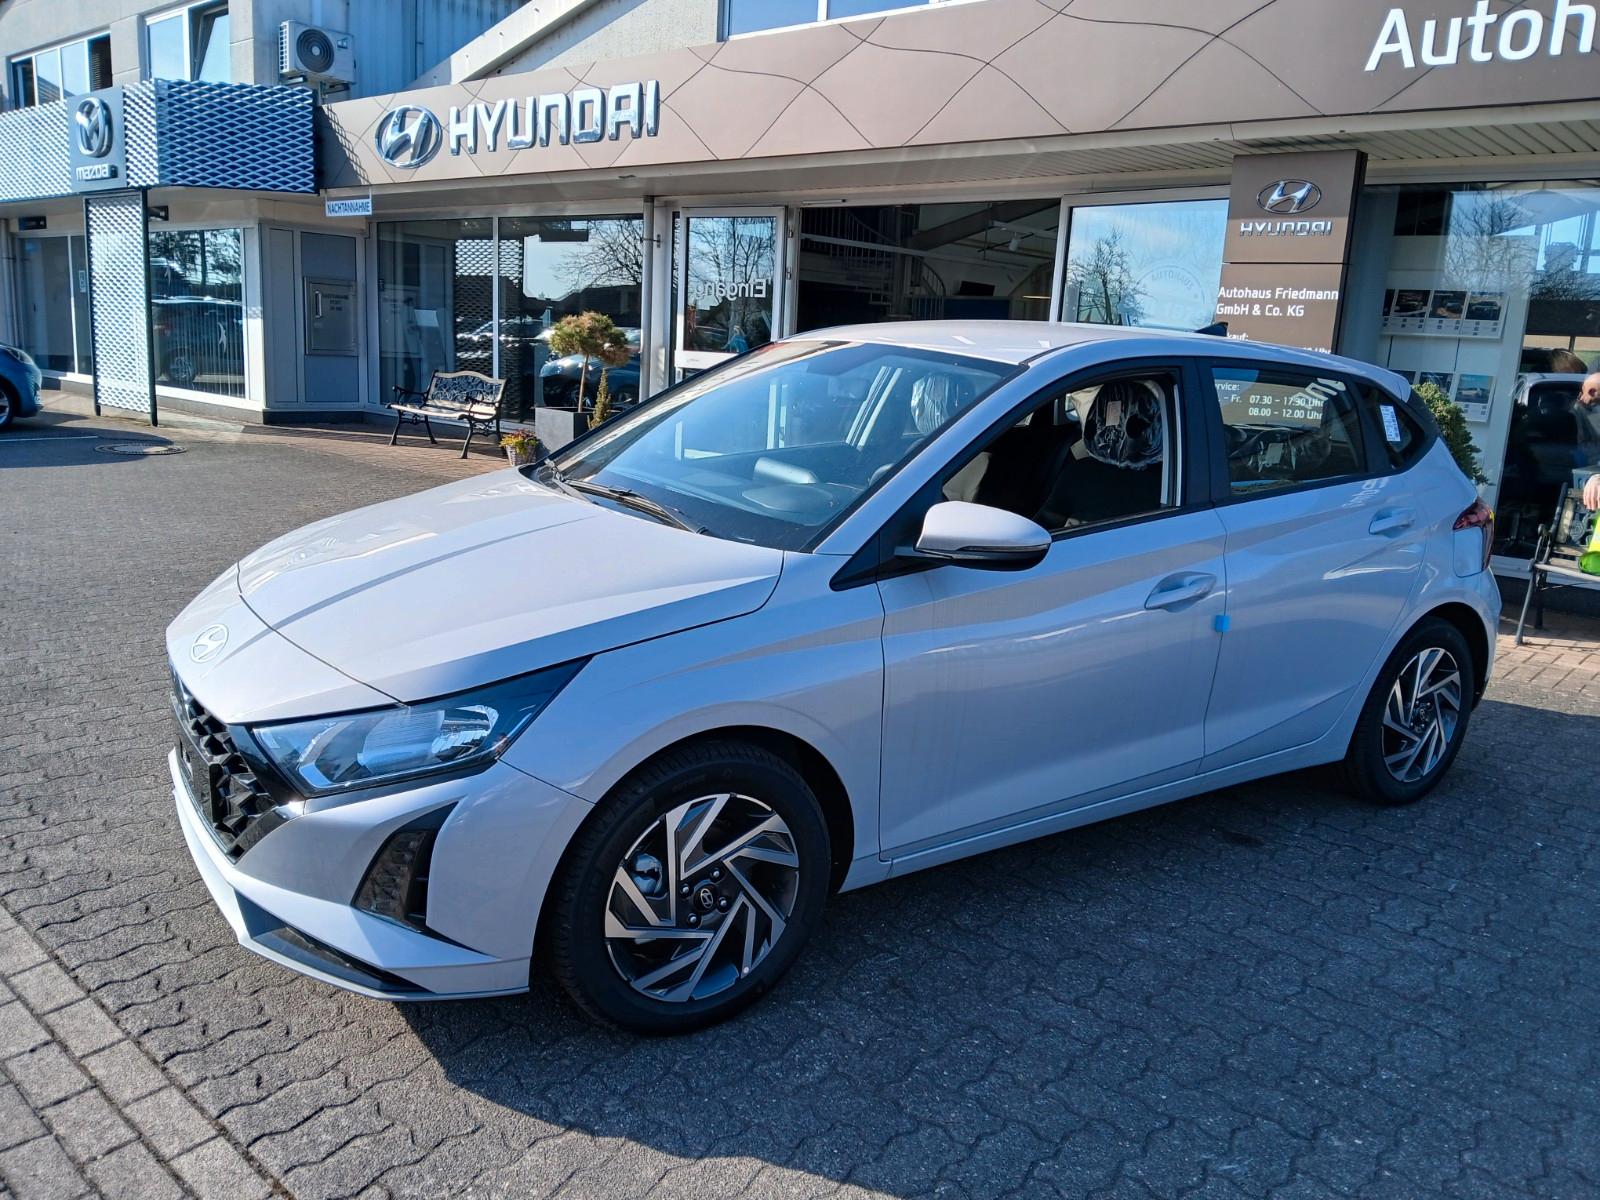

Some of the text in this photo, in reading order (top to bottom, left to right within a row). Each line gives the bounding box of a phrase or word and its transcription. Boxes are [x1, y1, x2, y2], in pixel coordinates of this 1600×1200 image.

[1364, 0, 1597, 72] Autoh
[449, 79, 661, 156] HYUNDAI
[76, 163, 111, 181] mazda
[327, 201, 370, 214] NACHTANNAHME
[1240, 220, 1332, 237] HYUNDAI
[1217, 286, 1339, 300] Autohaus Friedmann
[1216, 303, 1305, 317] GmbH & Co. KG
[1249, 394, 1273, 405] 07.30
[1248, 407, 1272, 417] 08.00
[1281, 408, 1305, 419] 12.00
[1306, 410, 1323, 420] Uhr
